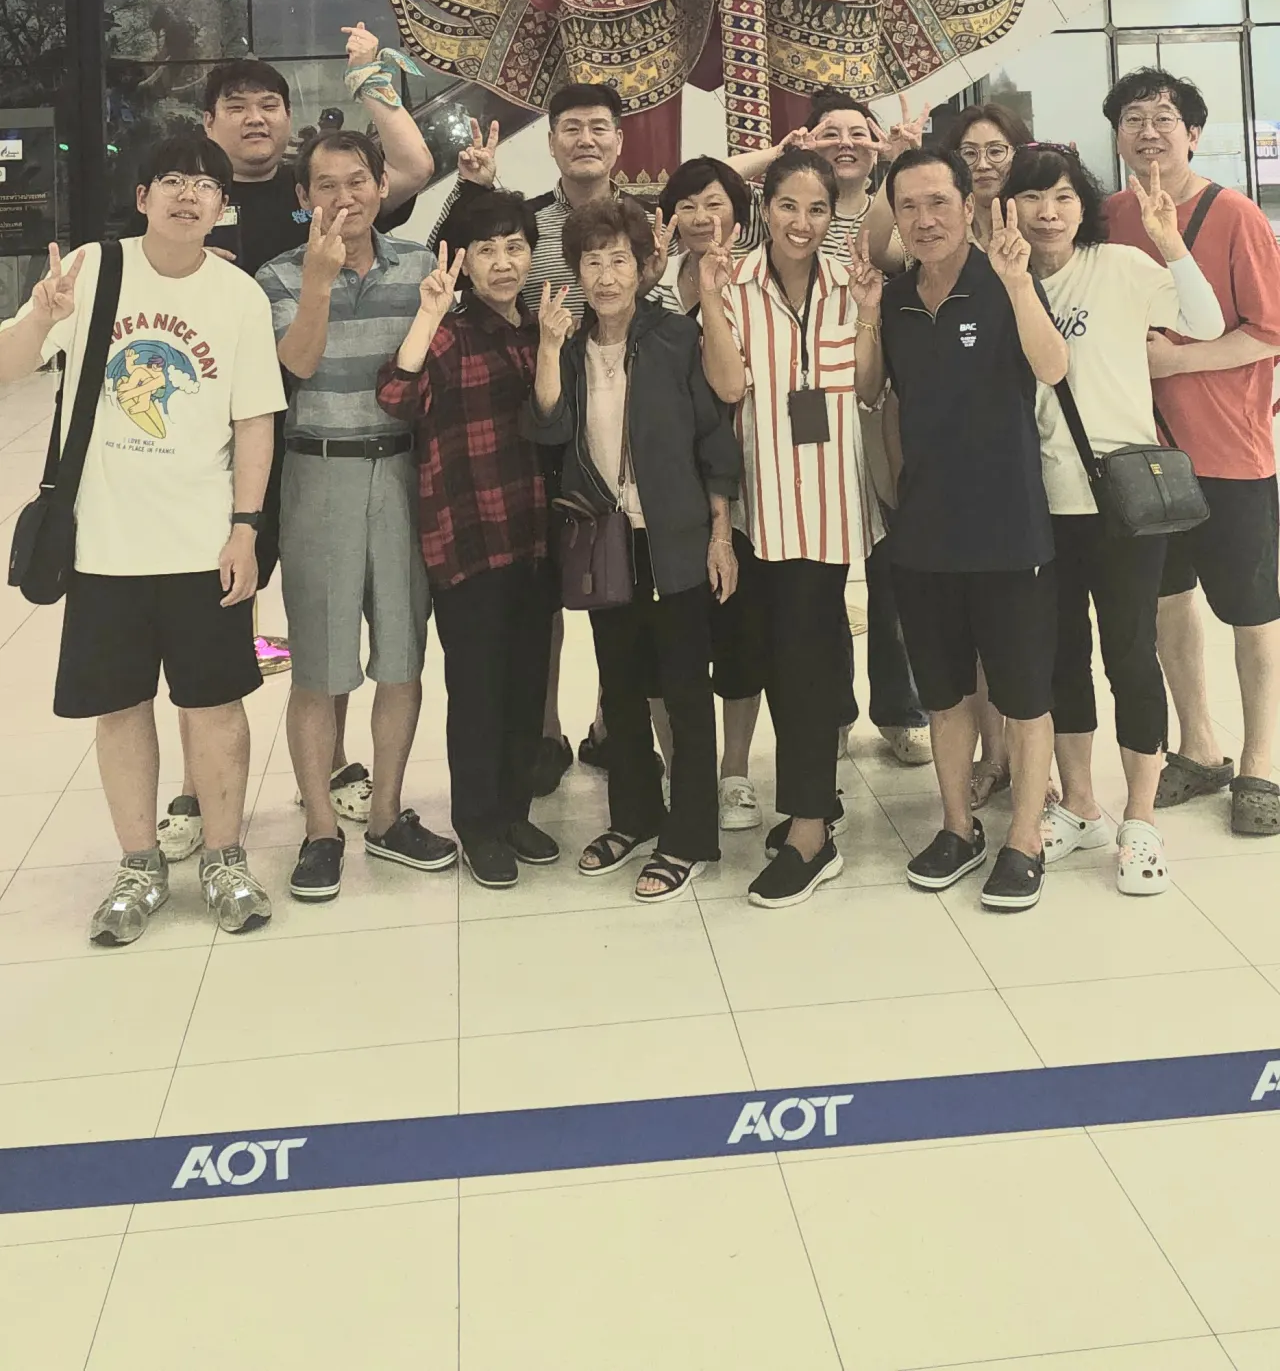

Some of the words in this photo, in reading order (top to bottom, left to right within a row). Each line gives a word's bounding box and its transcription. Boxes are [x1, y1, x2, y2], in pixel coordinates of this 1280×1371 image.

[136, 312, 149, 329] A
[153, 313, 198, 345] NICE
[191, 341, 218, 380] DAY
[128, 437, 141, 445] LOVE
[128, 444, 145, 452] PLACE
[727, 1093, 854, 1145] AOT
[171, 1137, 308, 1189] AOT
